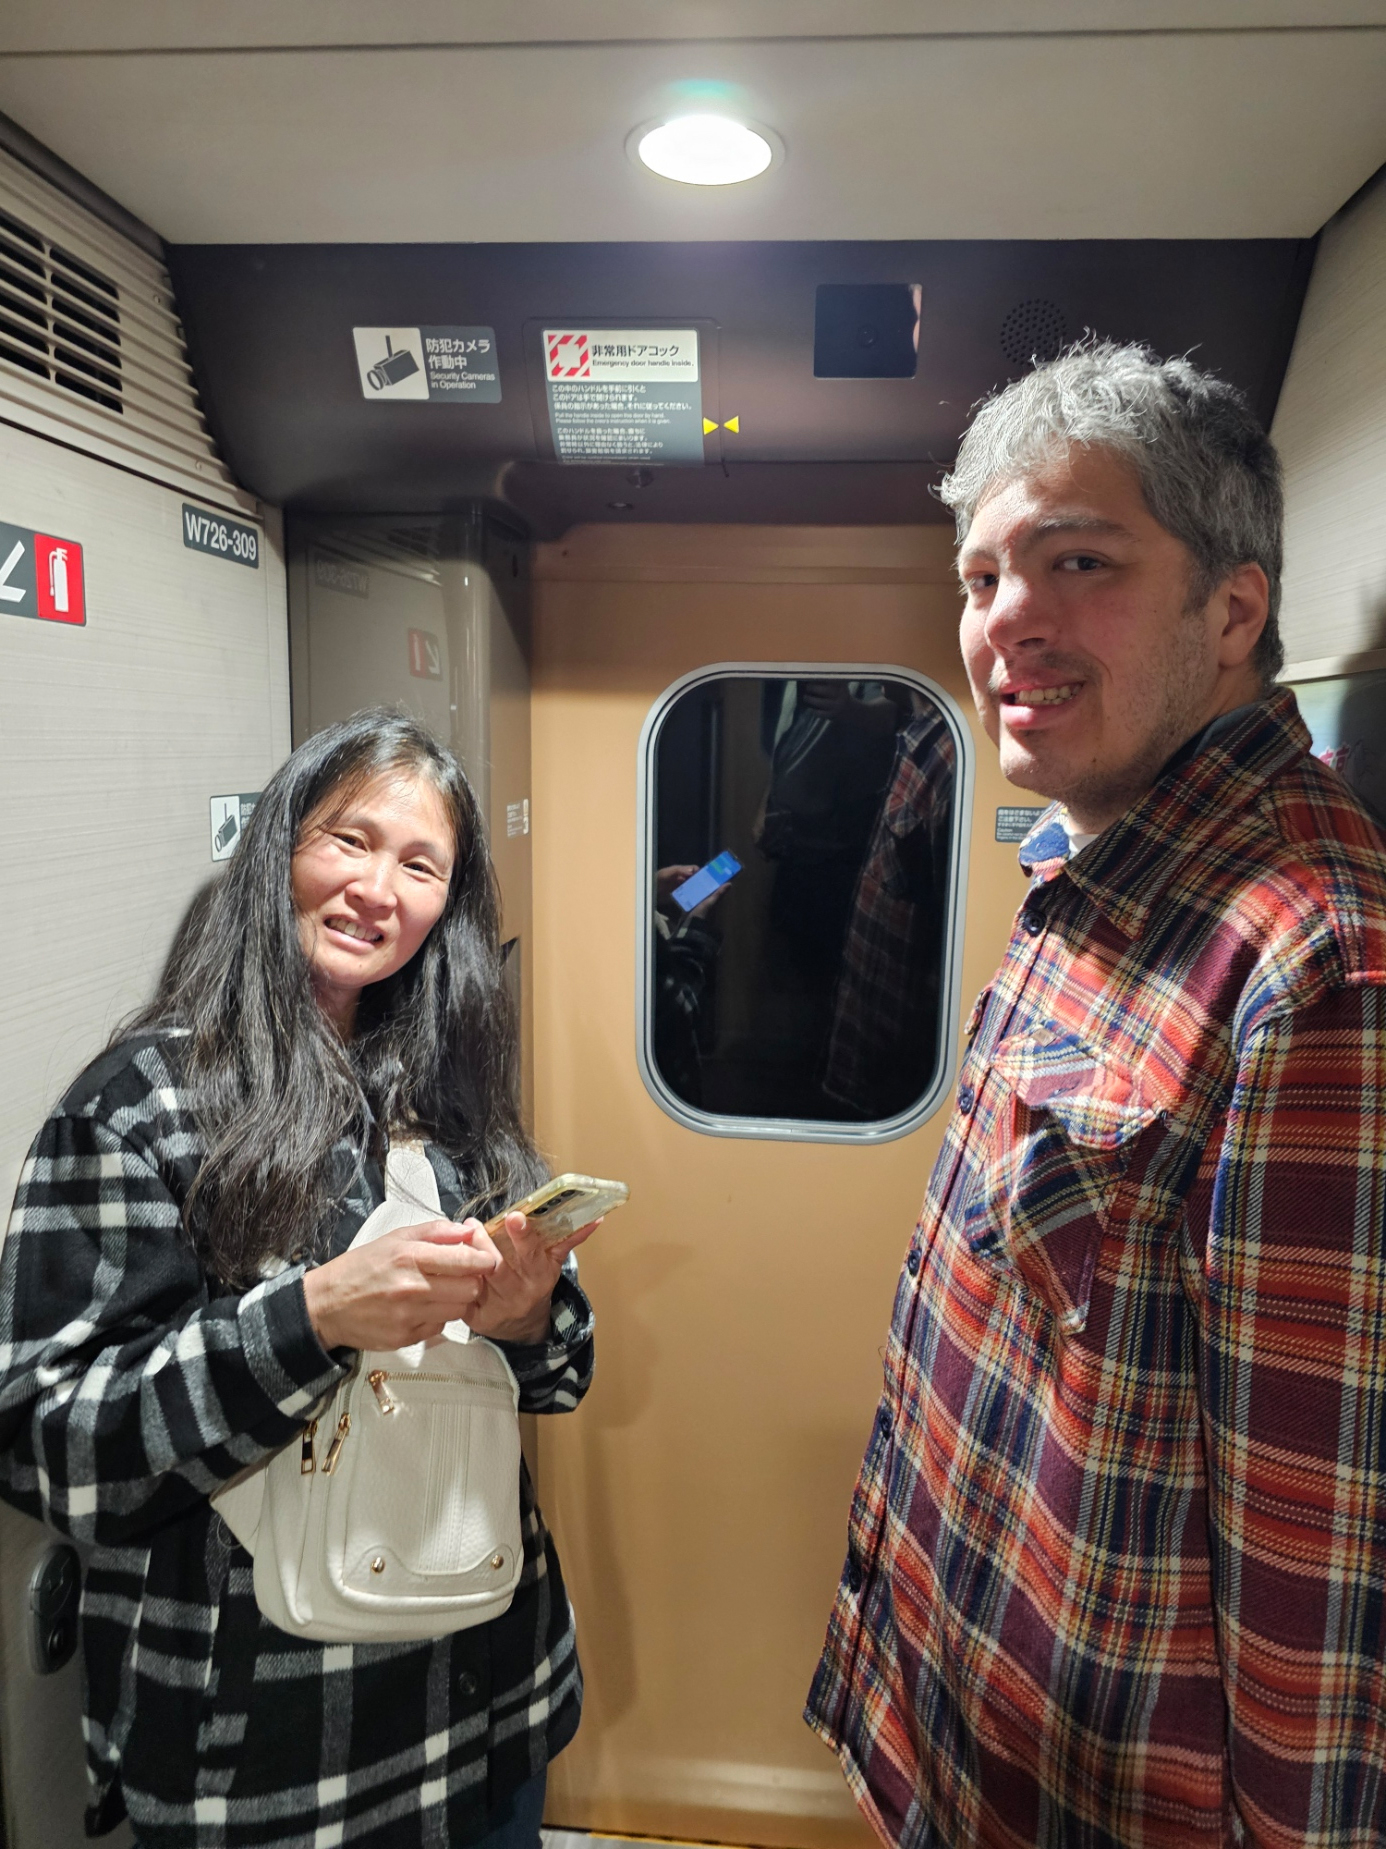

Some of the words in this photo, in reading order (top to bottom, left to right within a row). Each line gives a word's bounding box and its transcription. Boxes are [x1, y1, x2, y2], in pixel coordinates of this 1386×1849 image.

[425, 338, 491, 354] 防犯カメラ
[592, 344, 679, 357] 非常用ドアコック
[428, 354, 468, 370] 作動中
[592, 360, 629, 368] Emergency
[430, 371, 460, 382] Security
[461, 371, 495, 381] Cameras
[431, 381, 439, 389] in
[440, 381, 476, 390] Operation
[185, 511, 257, 561] W726-309
